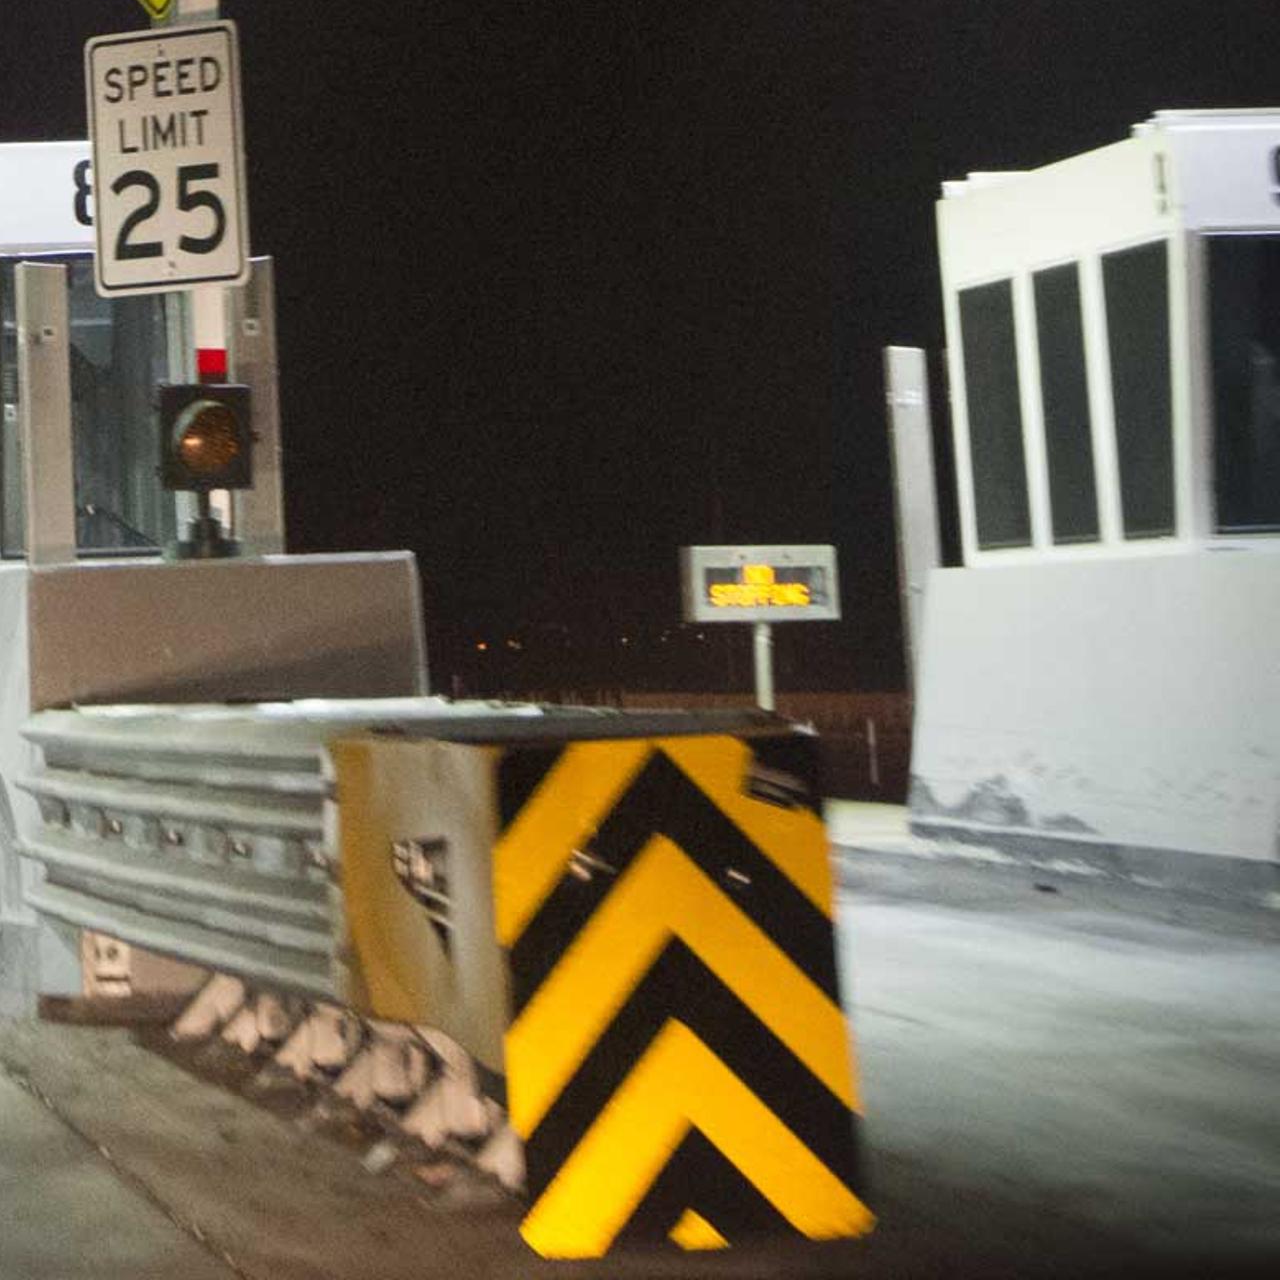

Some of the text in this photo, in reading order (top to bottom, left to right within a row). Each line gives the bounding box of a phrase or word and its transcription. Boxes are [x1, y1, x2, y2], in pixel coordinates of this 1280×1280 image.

[104, 56, 221, 104] SPEED
[118, 109, 209, 154] LIMIT
[110, 162, 226, 261] 25
